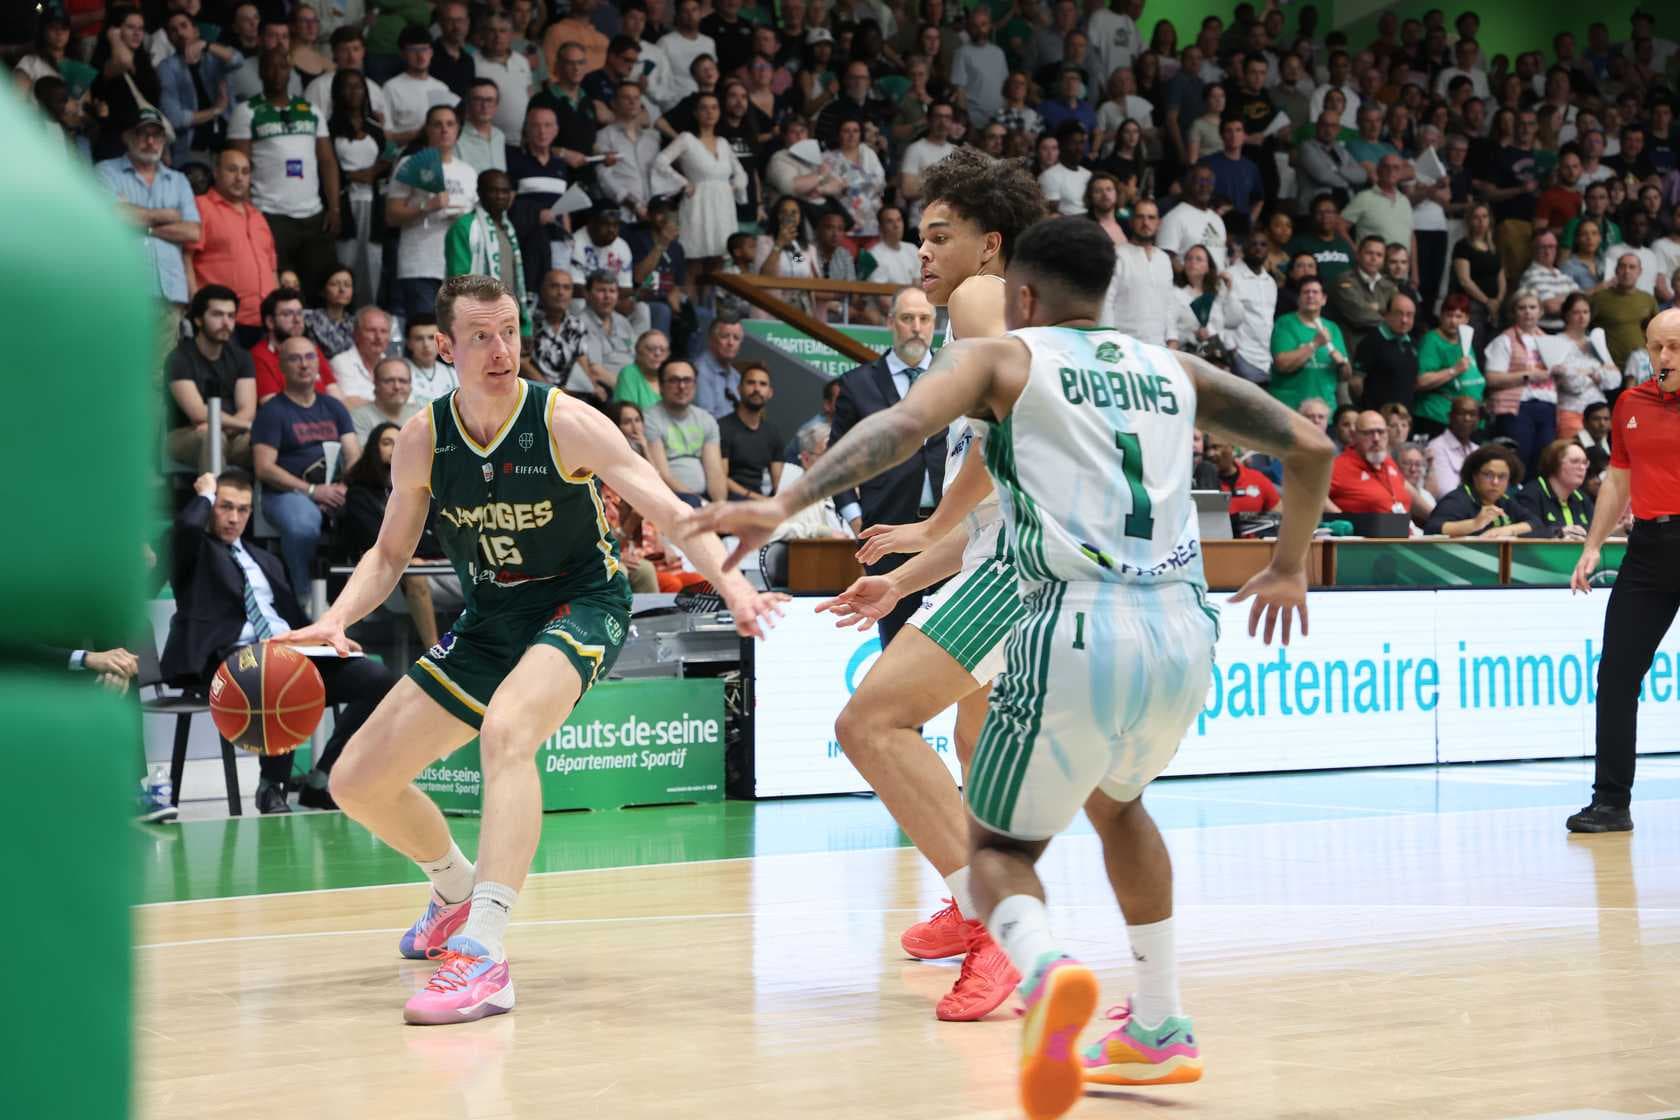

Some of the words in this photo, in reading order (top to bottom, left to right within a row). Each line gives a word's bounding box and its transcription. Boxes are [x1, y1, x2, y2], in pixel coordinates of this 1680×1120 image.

[1059, 367, 1179, 416] BIBBINS
[1115, 430, 1154, 540] 1
[1072, 612, 1085, 650] 1
[1197, 643, 1439, 736] partenaire
[1459, 639, 1680, 708] immobe
[546, 754, 637, 775] Département
[640, 748, 687, 771] Sportif
